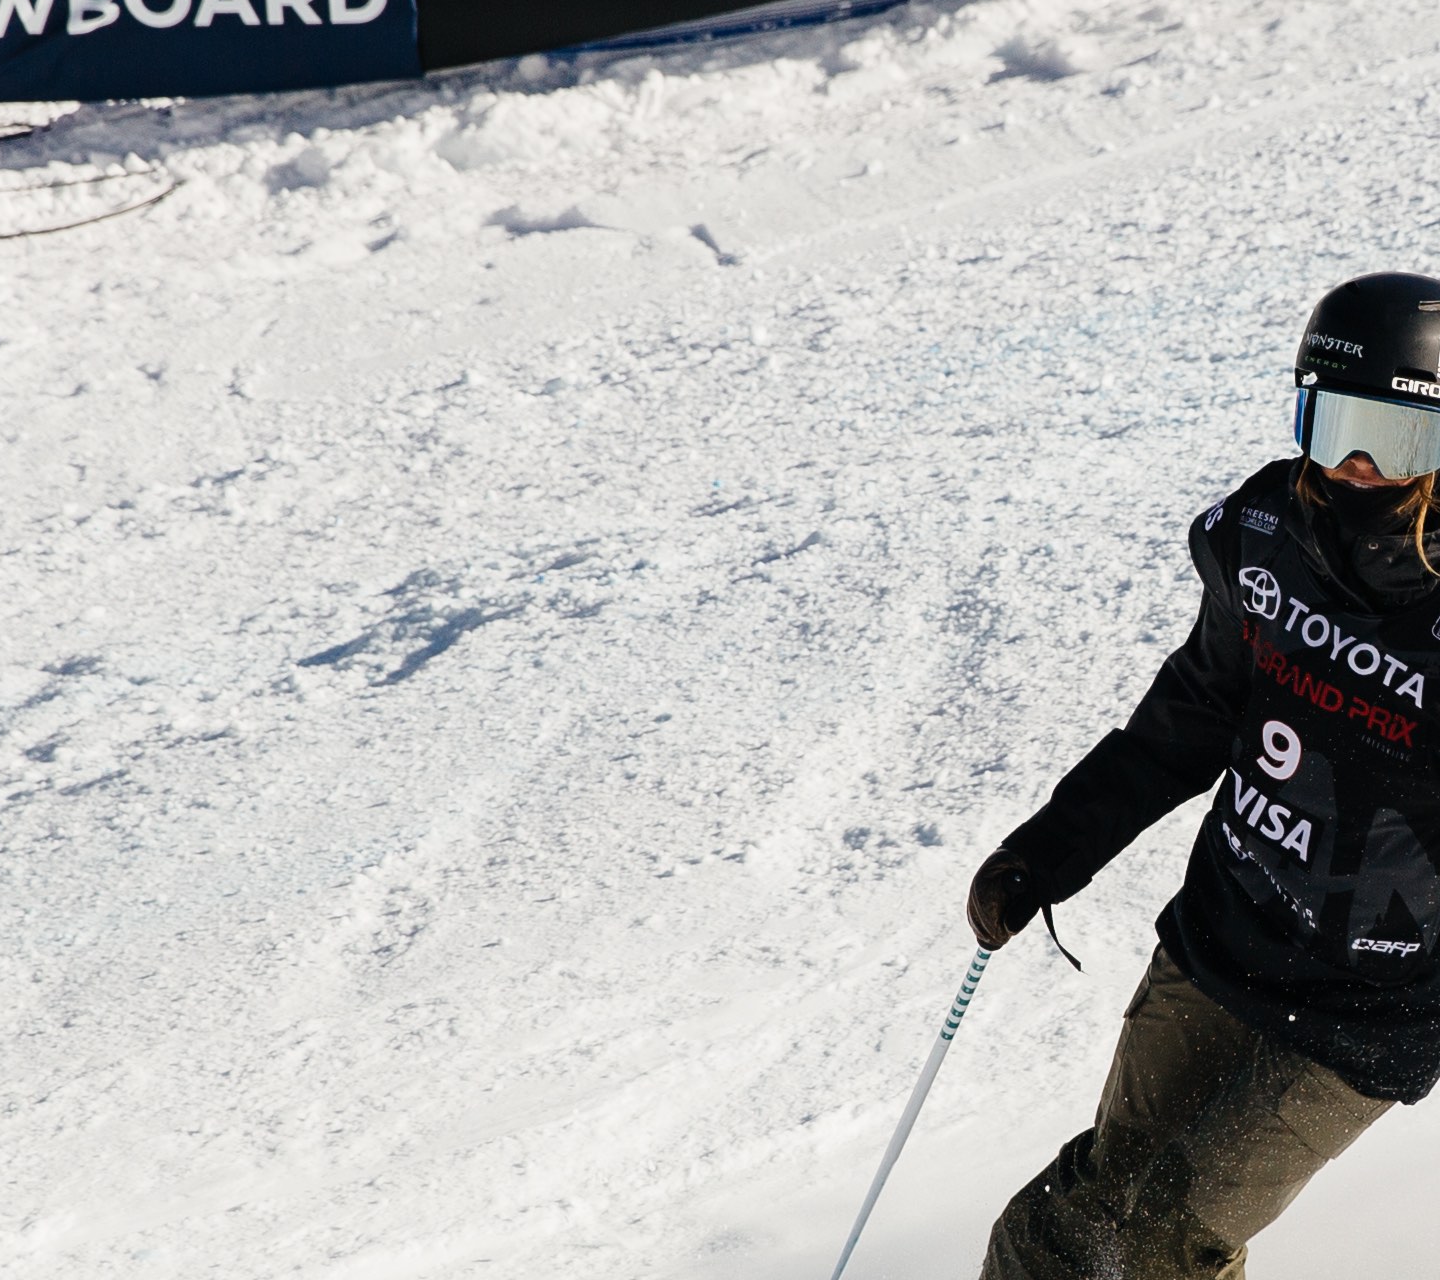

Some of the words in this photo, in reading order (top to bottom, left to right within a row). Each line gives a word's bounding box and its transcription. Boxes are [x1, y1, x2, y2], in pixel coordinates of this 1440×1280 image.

[1241, 506, 1279, 525] FREESKI
[1257, 640, 1344, 713] GRAND
[1347, 696, 1418, 748] PRIX
[1284, 596, 1425, 709] TOYOTA
[1256, 720, 1302, 781] 9
[1229, 766, 1312, 862] VISA
